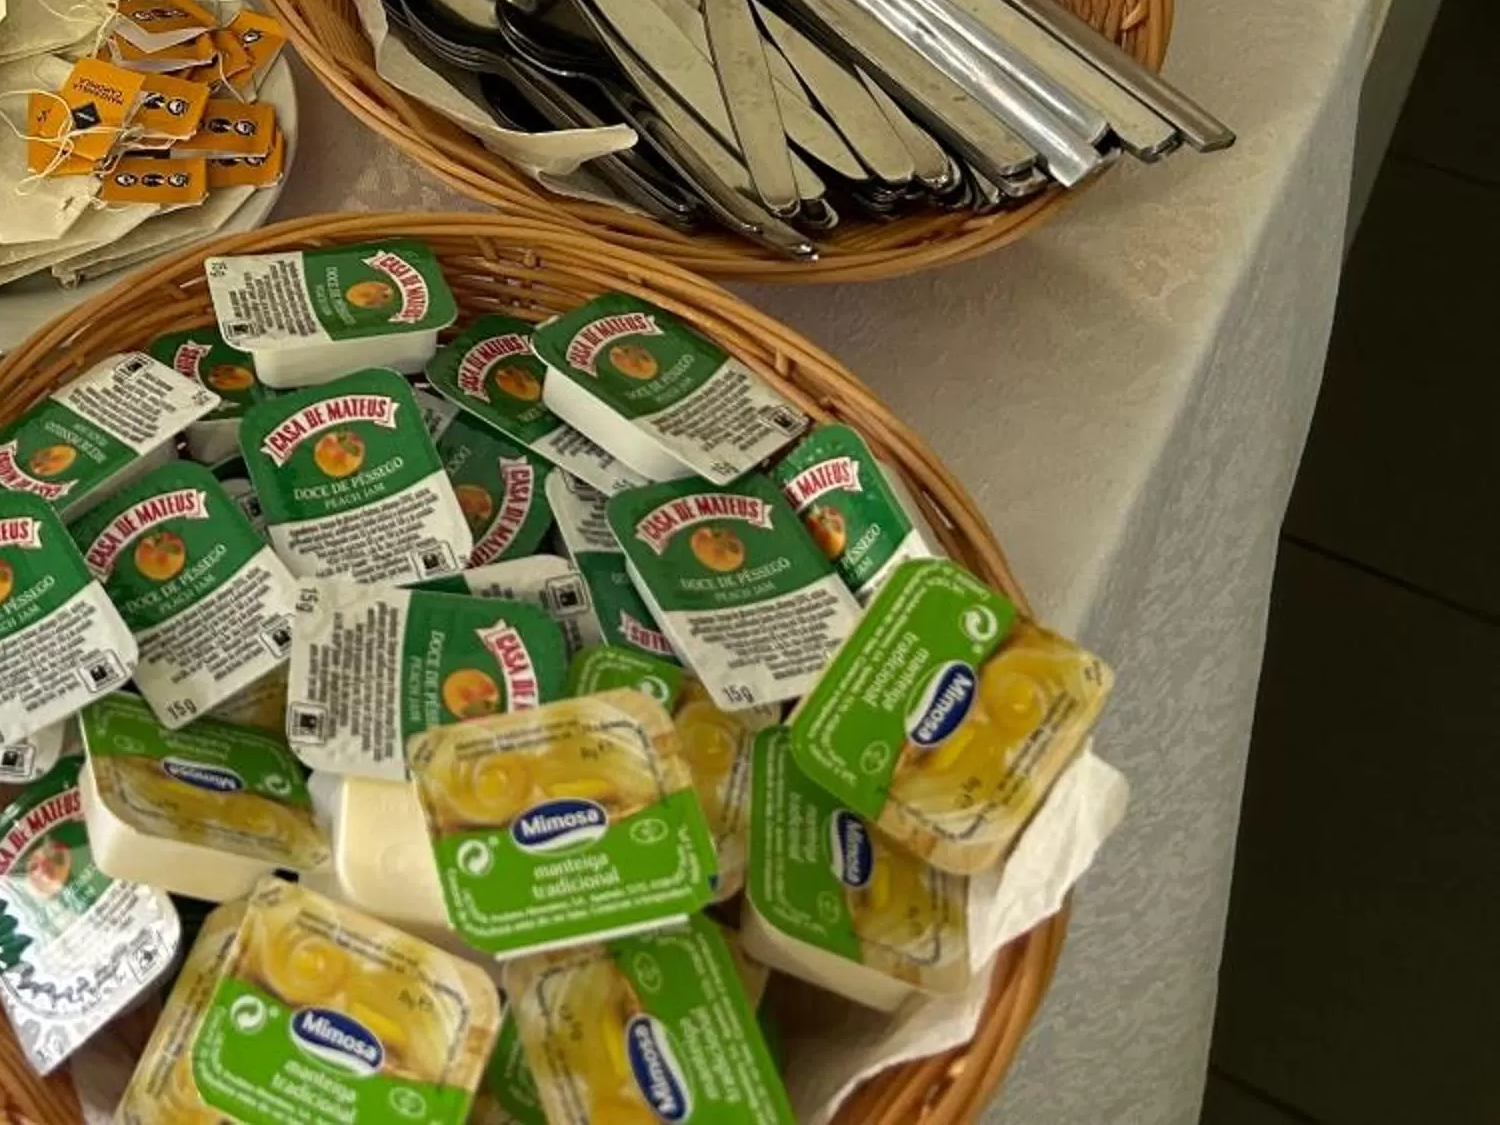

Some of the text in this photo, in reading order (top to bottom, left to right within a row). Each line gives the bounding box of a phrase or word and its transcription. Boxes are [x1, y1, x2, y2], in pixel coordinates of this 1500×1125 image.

[593, 314, 647, 339] MATEUS
[475, 336, 523, 363] MATEUS
[269, 397, 387, 452] CASA DE MATEUS
[293, 484, 329, 501] DOCE
[331, 480, 351, 495] DE
[796, 460, 851, 497] MATEUS
[87, 492, 195, 571] CASA DE MATEUS
[466, 469, 531, 569] CASA DE MATEU
[642, 509, 679, 541] CASA
[675, 498, 697, 519] DE
[697, 495, 759, 520] MATEUS
[160, 581, 181, 598] DE
[295, 587, 321, 614] 15g
[17, 605, 43, 626] JAM
[425, 630, 446, 668] DOCE
[495, 633, 528, 675] CASA
[165, 698, 198, 721] 15g
[722, 684, 755, 704] 15g
[918, 672, 974, 742] Mimosa
[27, 790, 81, 836] MATEUS
[520, 807, 600, 837] Mimosa
[531, 866, 621, 899] tradicional
[532, 852, 609, 880] manteiga
[301, 1010, 378, 1060] Mimosa
[634, 1025, 677, 1114] Mimosa
